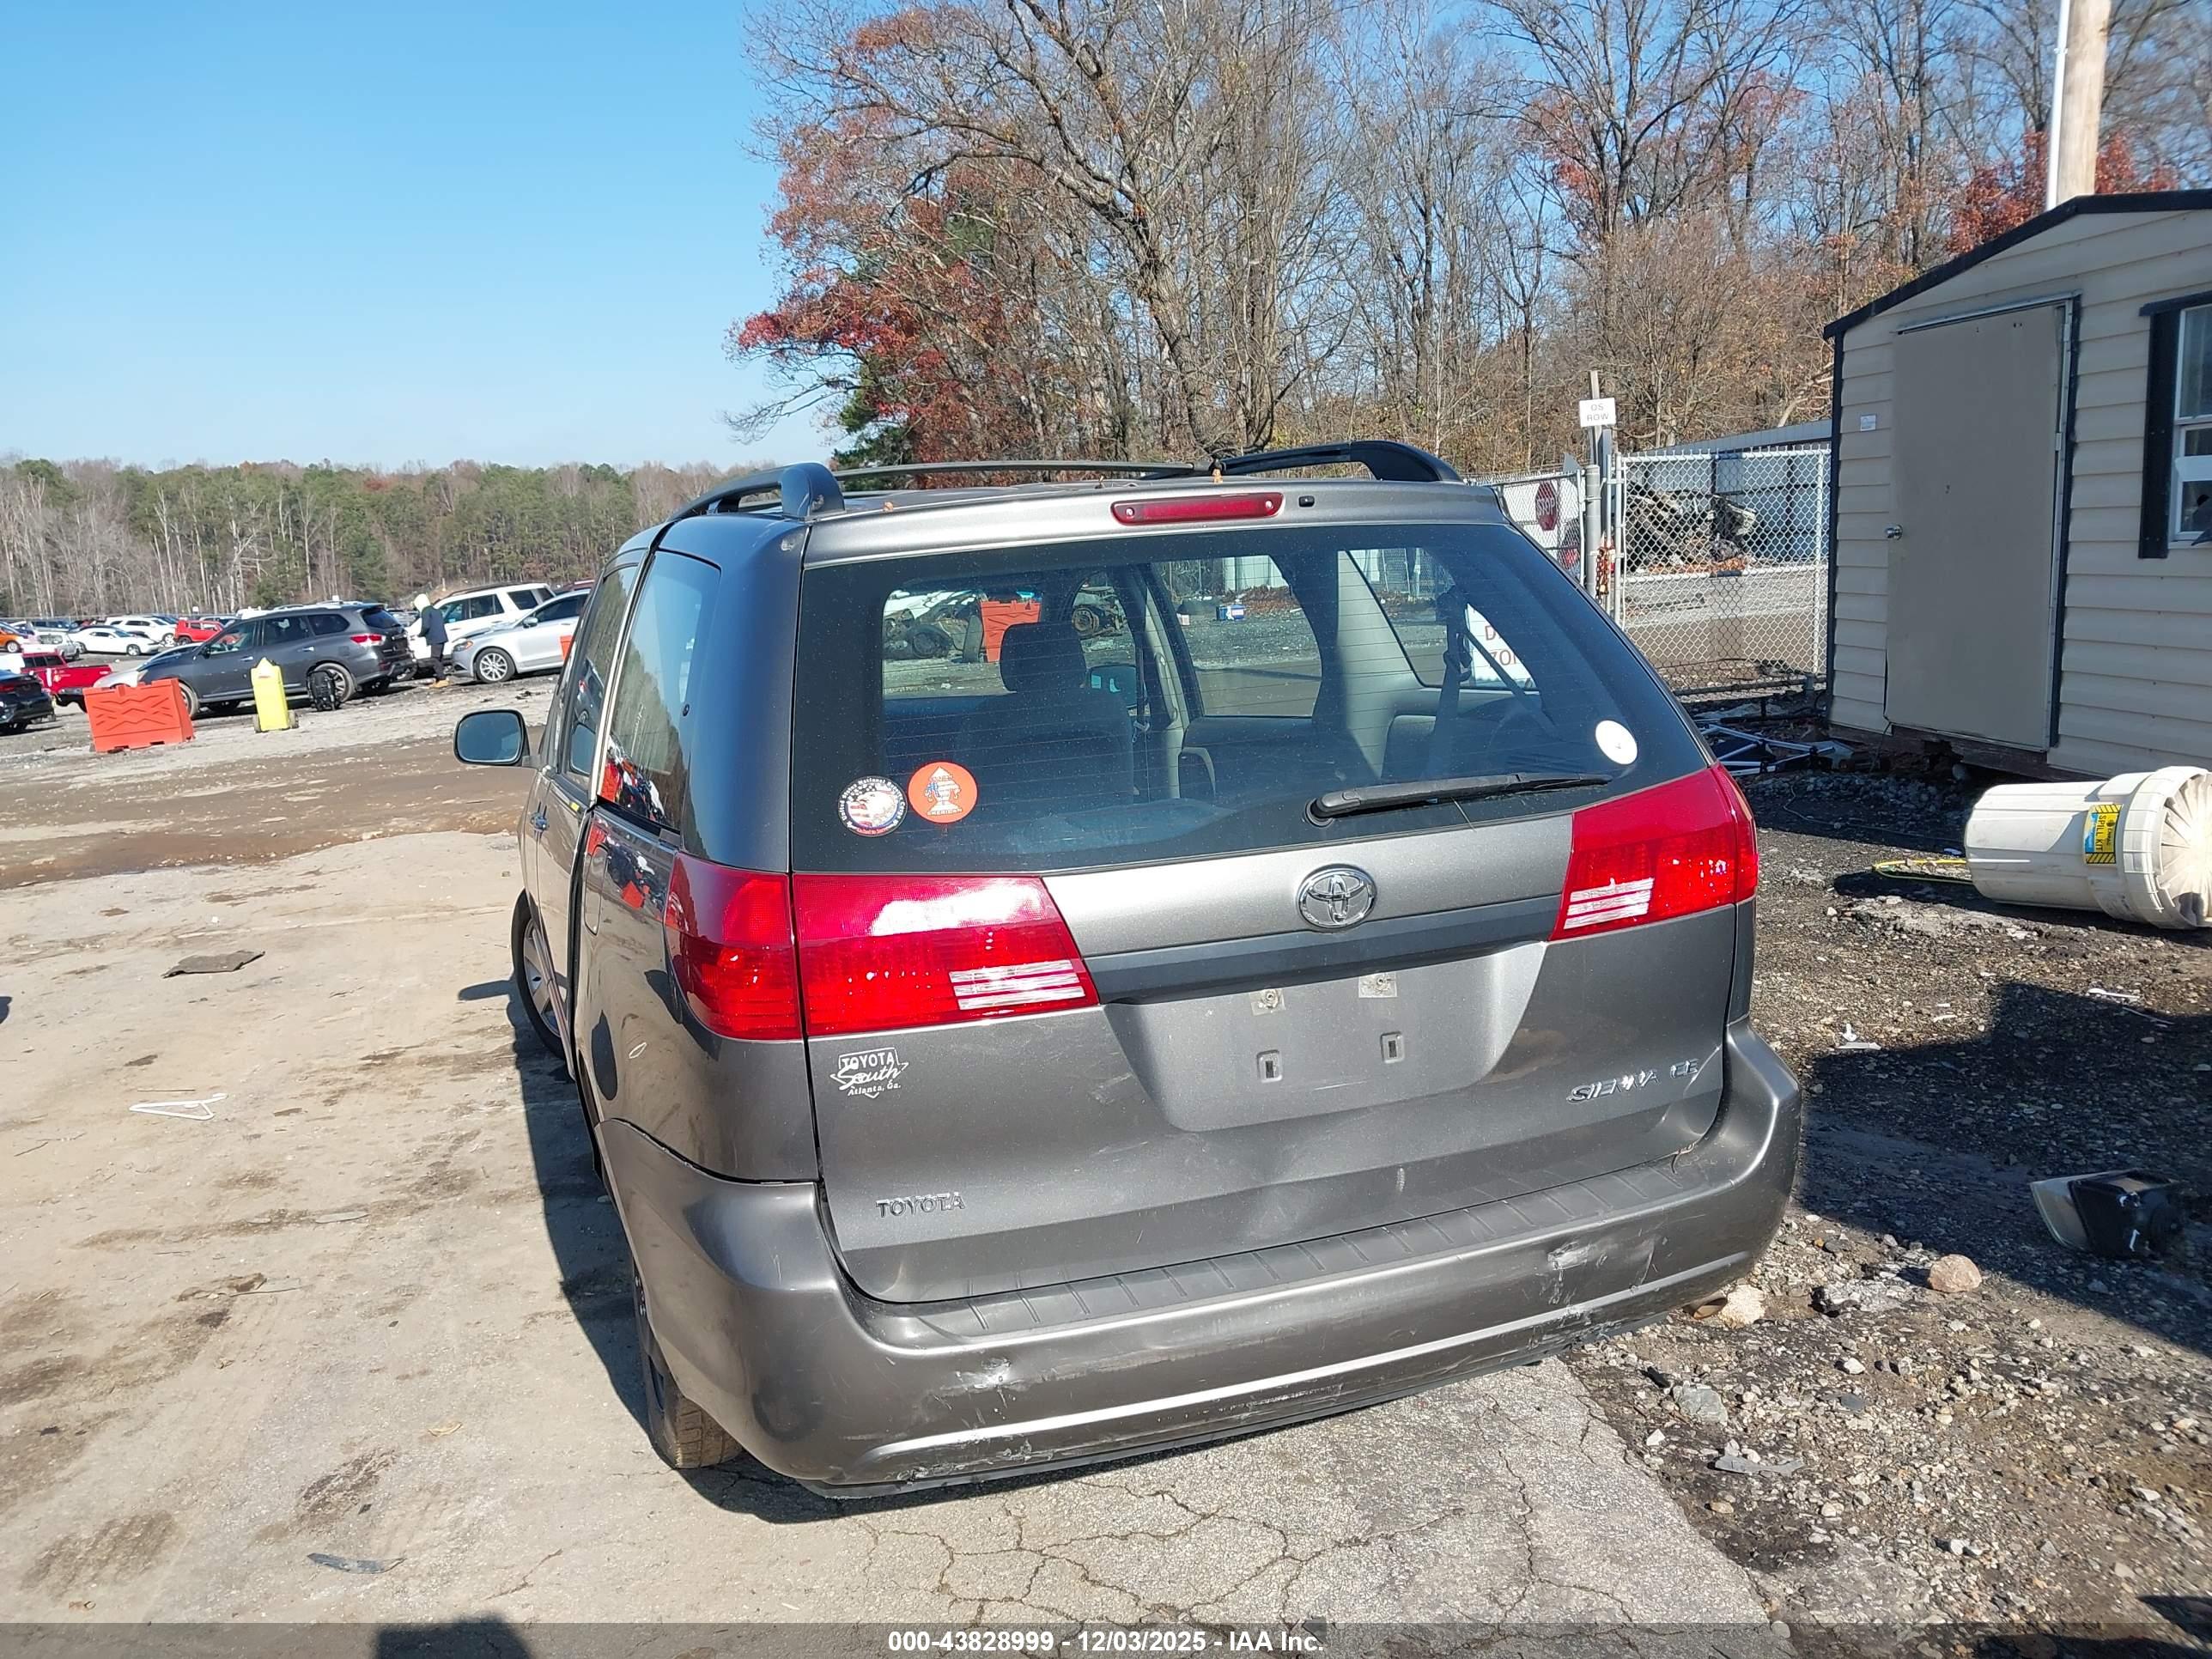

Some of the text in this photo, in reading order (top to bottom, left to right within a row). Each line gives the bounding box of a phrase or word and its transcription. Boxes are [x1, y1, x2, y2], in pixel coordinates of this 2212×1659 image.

[1586, 413, 1609, 422] ROW
[1536, 497, 1555, 515] STOP
[2096, 815, 2107, 836] SPILL
[842, 1052, 895, 1070] TOYOTA
[837, 1064, 901, 1091] South
[876, 1192, 965, 1218] TOYOTA
